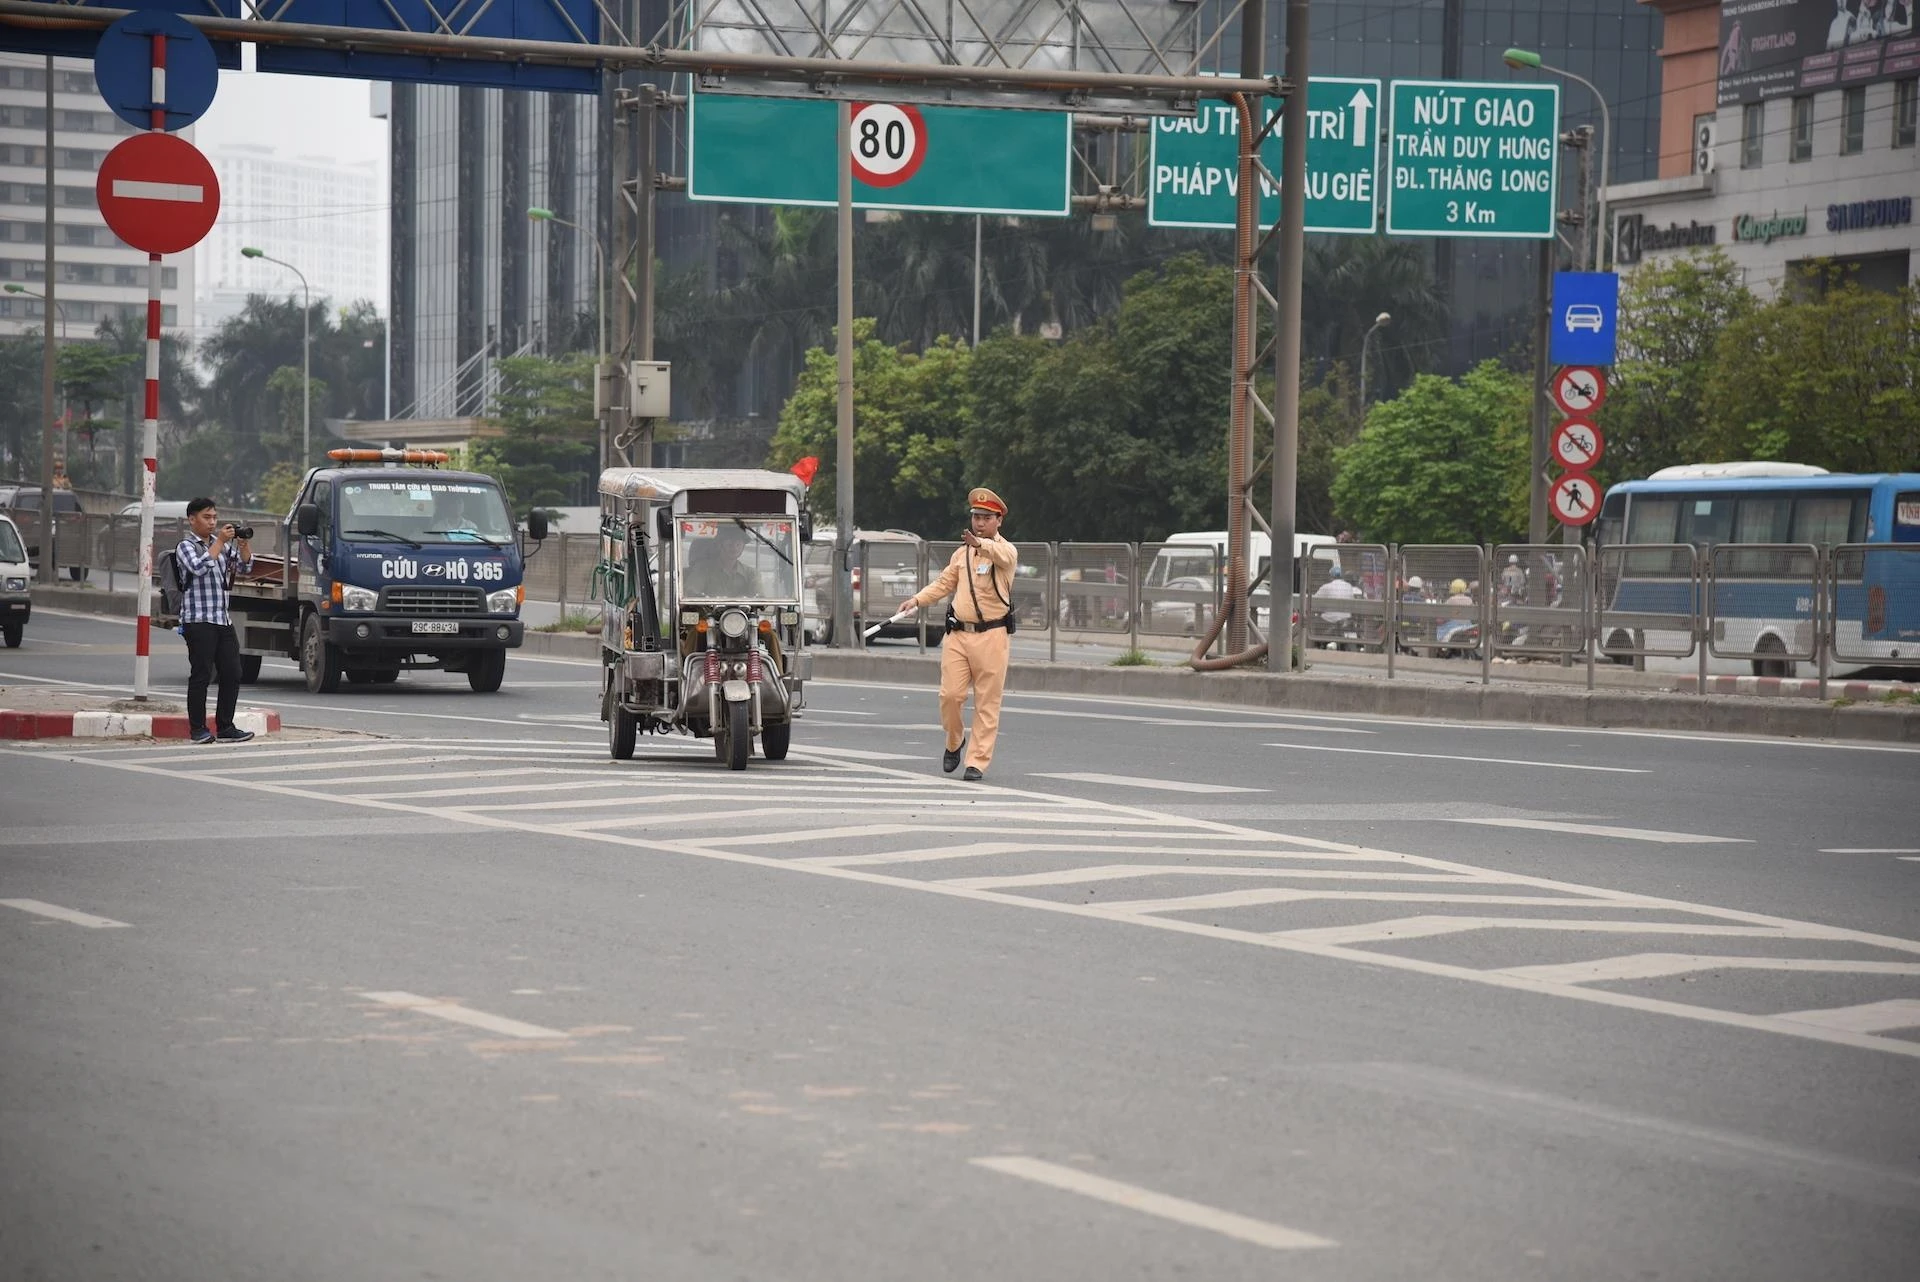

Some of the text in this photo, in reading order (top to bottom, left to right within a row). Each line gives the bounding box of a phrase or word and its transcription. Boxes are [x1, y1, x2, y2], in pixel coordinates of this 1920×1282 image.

[1751, 31, 1796, 52] FIGHTLAND
[1306, 106, 1346, 140] TRÌ
[1414, 89, 1535, 128] NÚT GIAO
[859, 118, 905, 160] 80
[1396, 128, 1551, 161] TRẦN DUY HƯNG
[1156, 162, 1222, 196] PHÁP
[1396, 164, 1550, 192] ĐL. THĂNG LONG
[1446, 200, 1496, 224] 3 Km
[1732, 211, 1808, 244] Kangaroo
[1827, 197, 1912, 232] SAMSUNG
[432, 484, 447, 492] GIAO
[381, 555, 503, 584] CỨU HỘ 365
